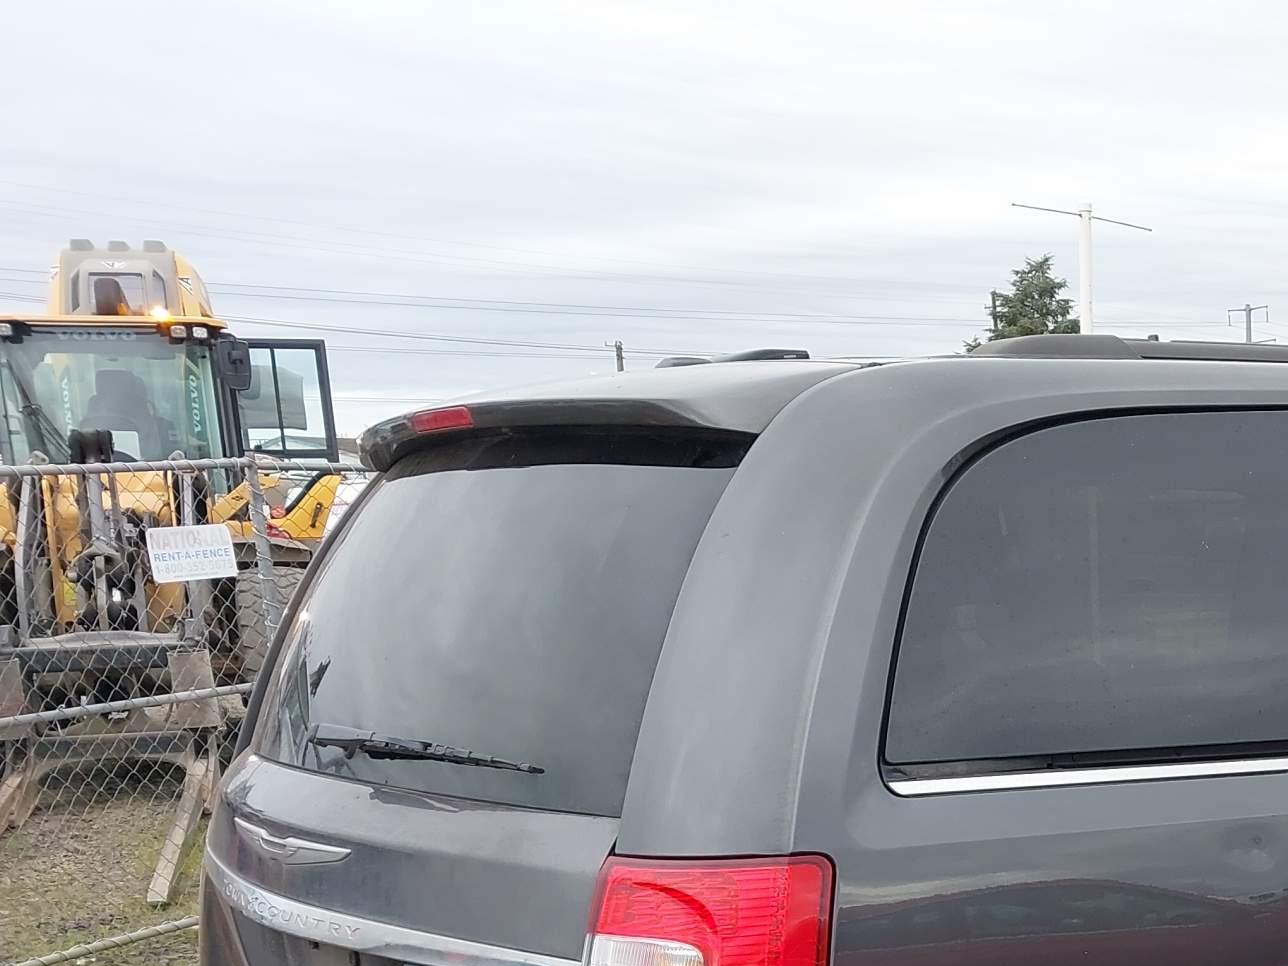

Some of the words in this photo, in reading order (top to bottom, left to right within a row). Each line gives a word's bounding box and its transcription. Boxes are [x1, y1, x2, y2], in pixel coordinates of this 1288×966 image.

[56, 330, 136, 341] VOLVO
[188, 375, 202, 432] VOLVO
[154, 547, 230, 562] RENT-A-FENCE
[255, 900, 361, 940] COUNTRY
